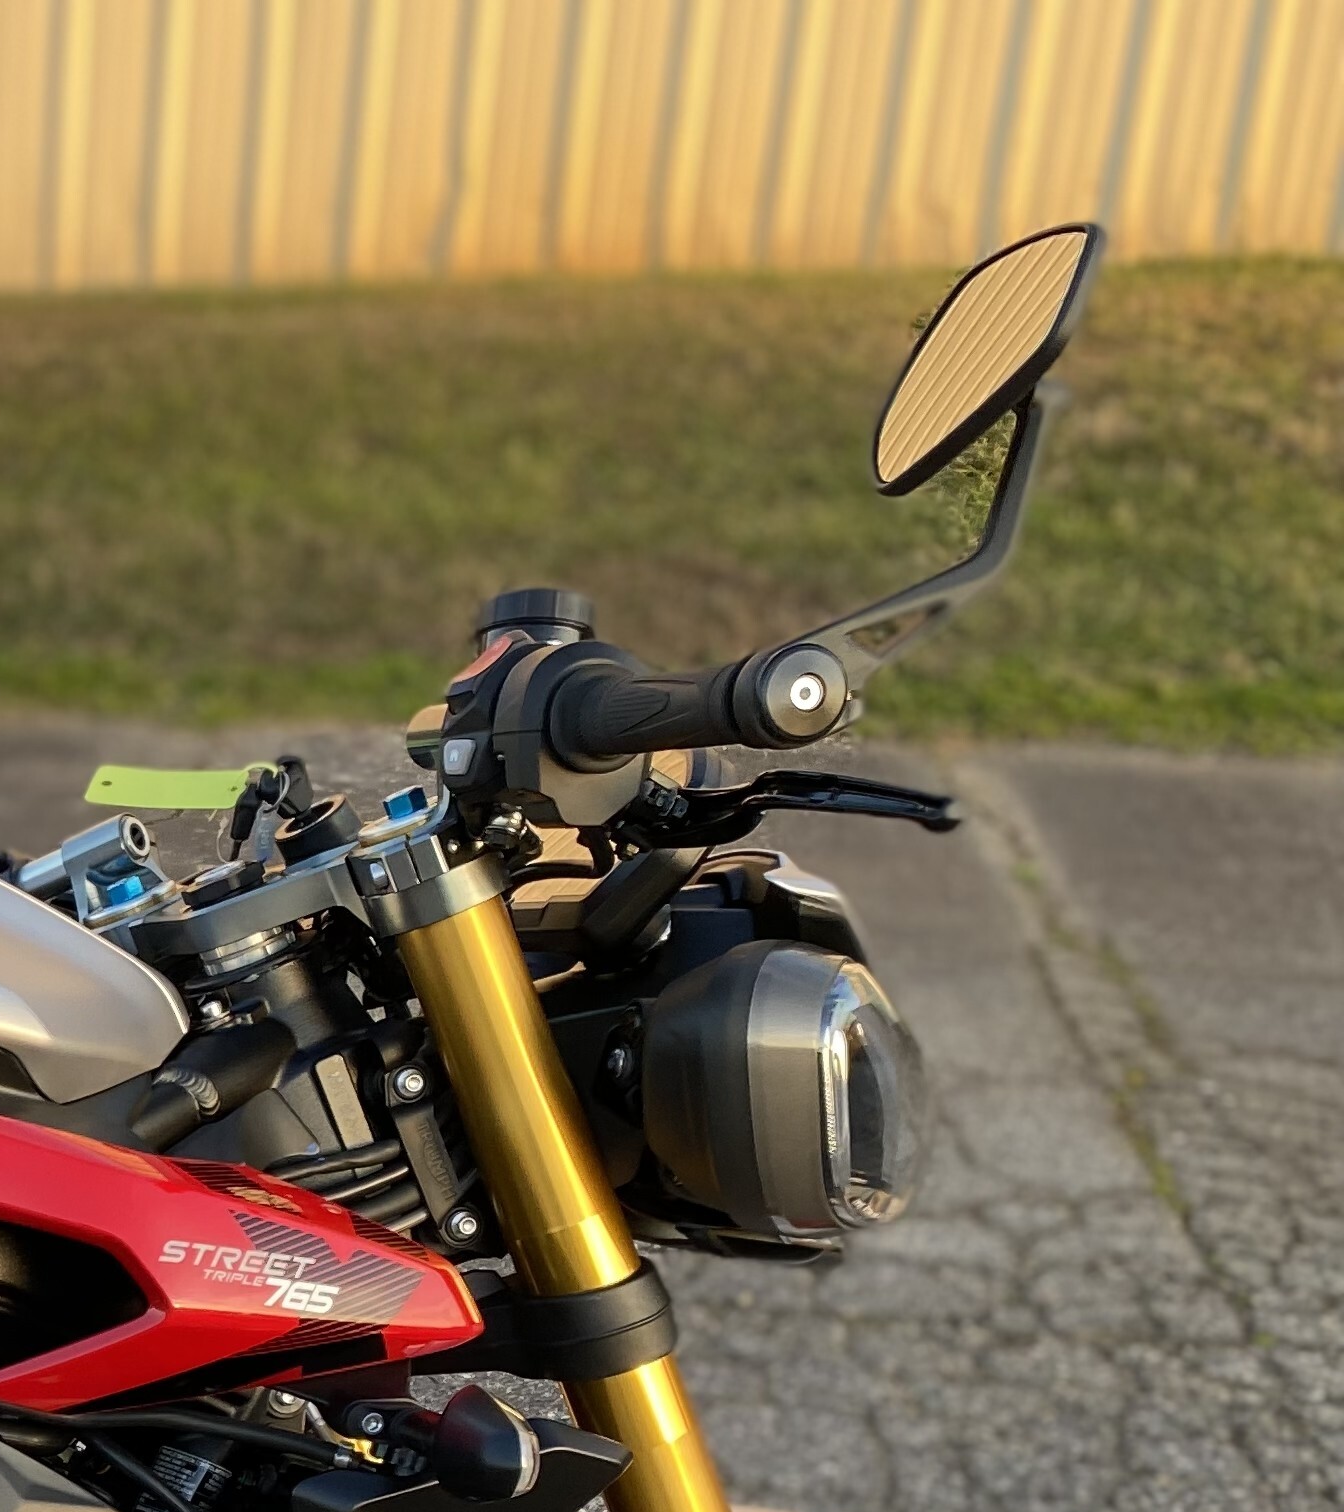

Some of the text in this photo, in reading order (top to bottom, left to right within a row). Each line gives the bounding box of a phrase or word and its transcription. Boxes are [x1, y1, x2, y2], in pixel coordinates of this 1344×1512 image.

[158, 1240, 317, 1279] STREET
[203, 1268, 340, 1314] TRIPLE 765
